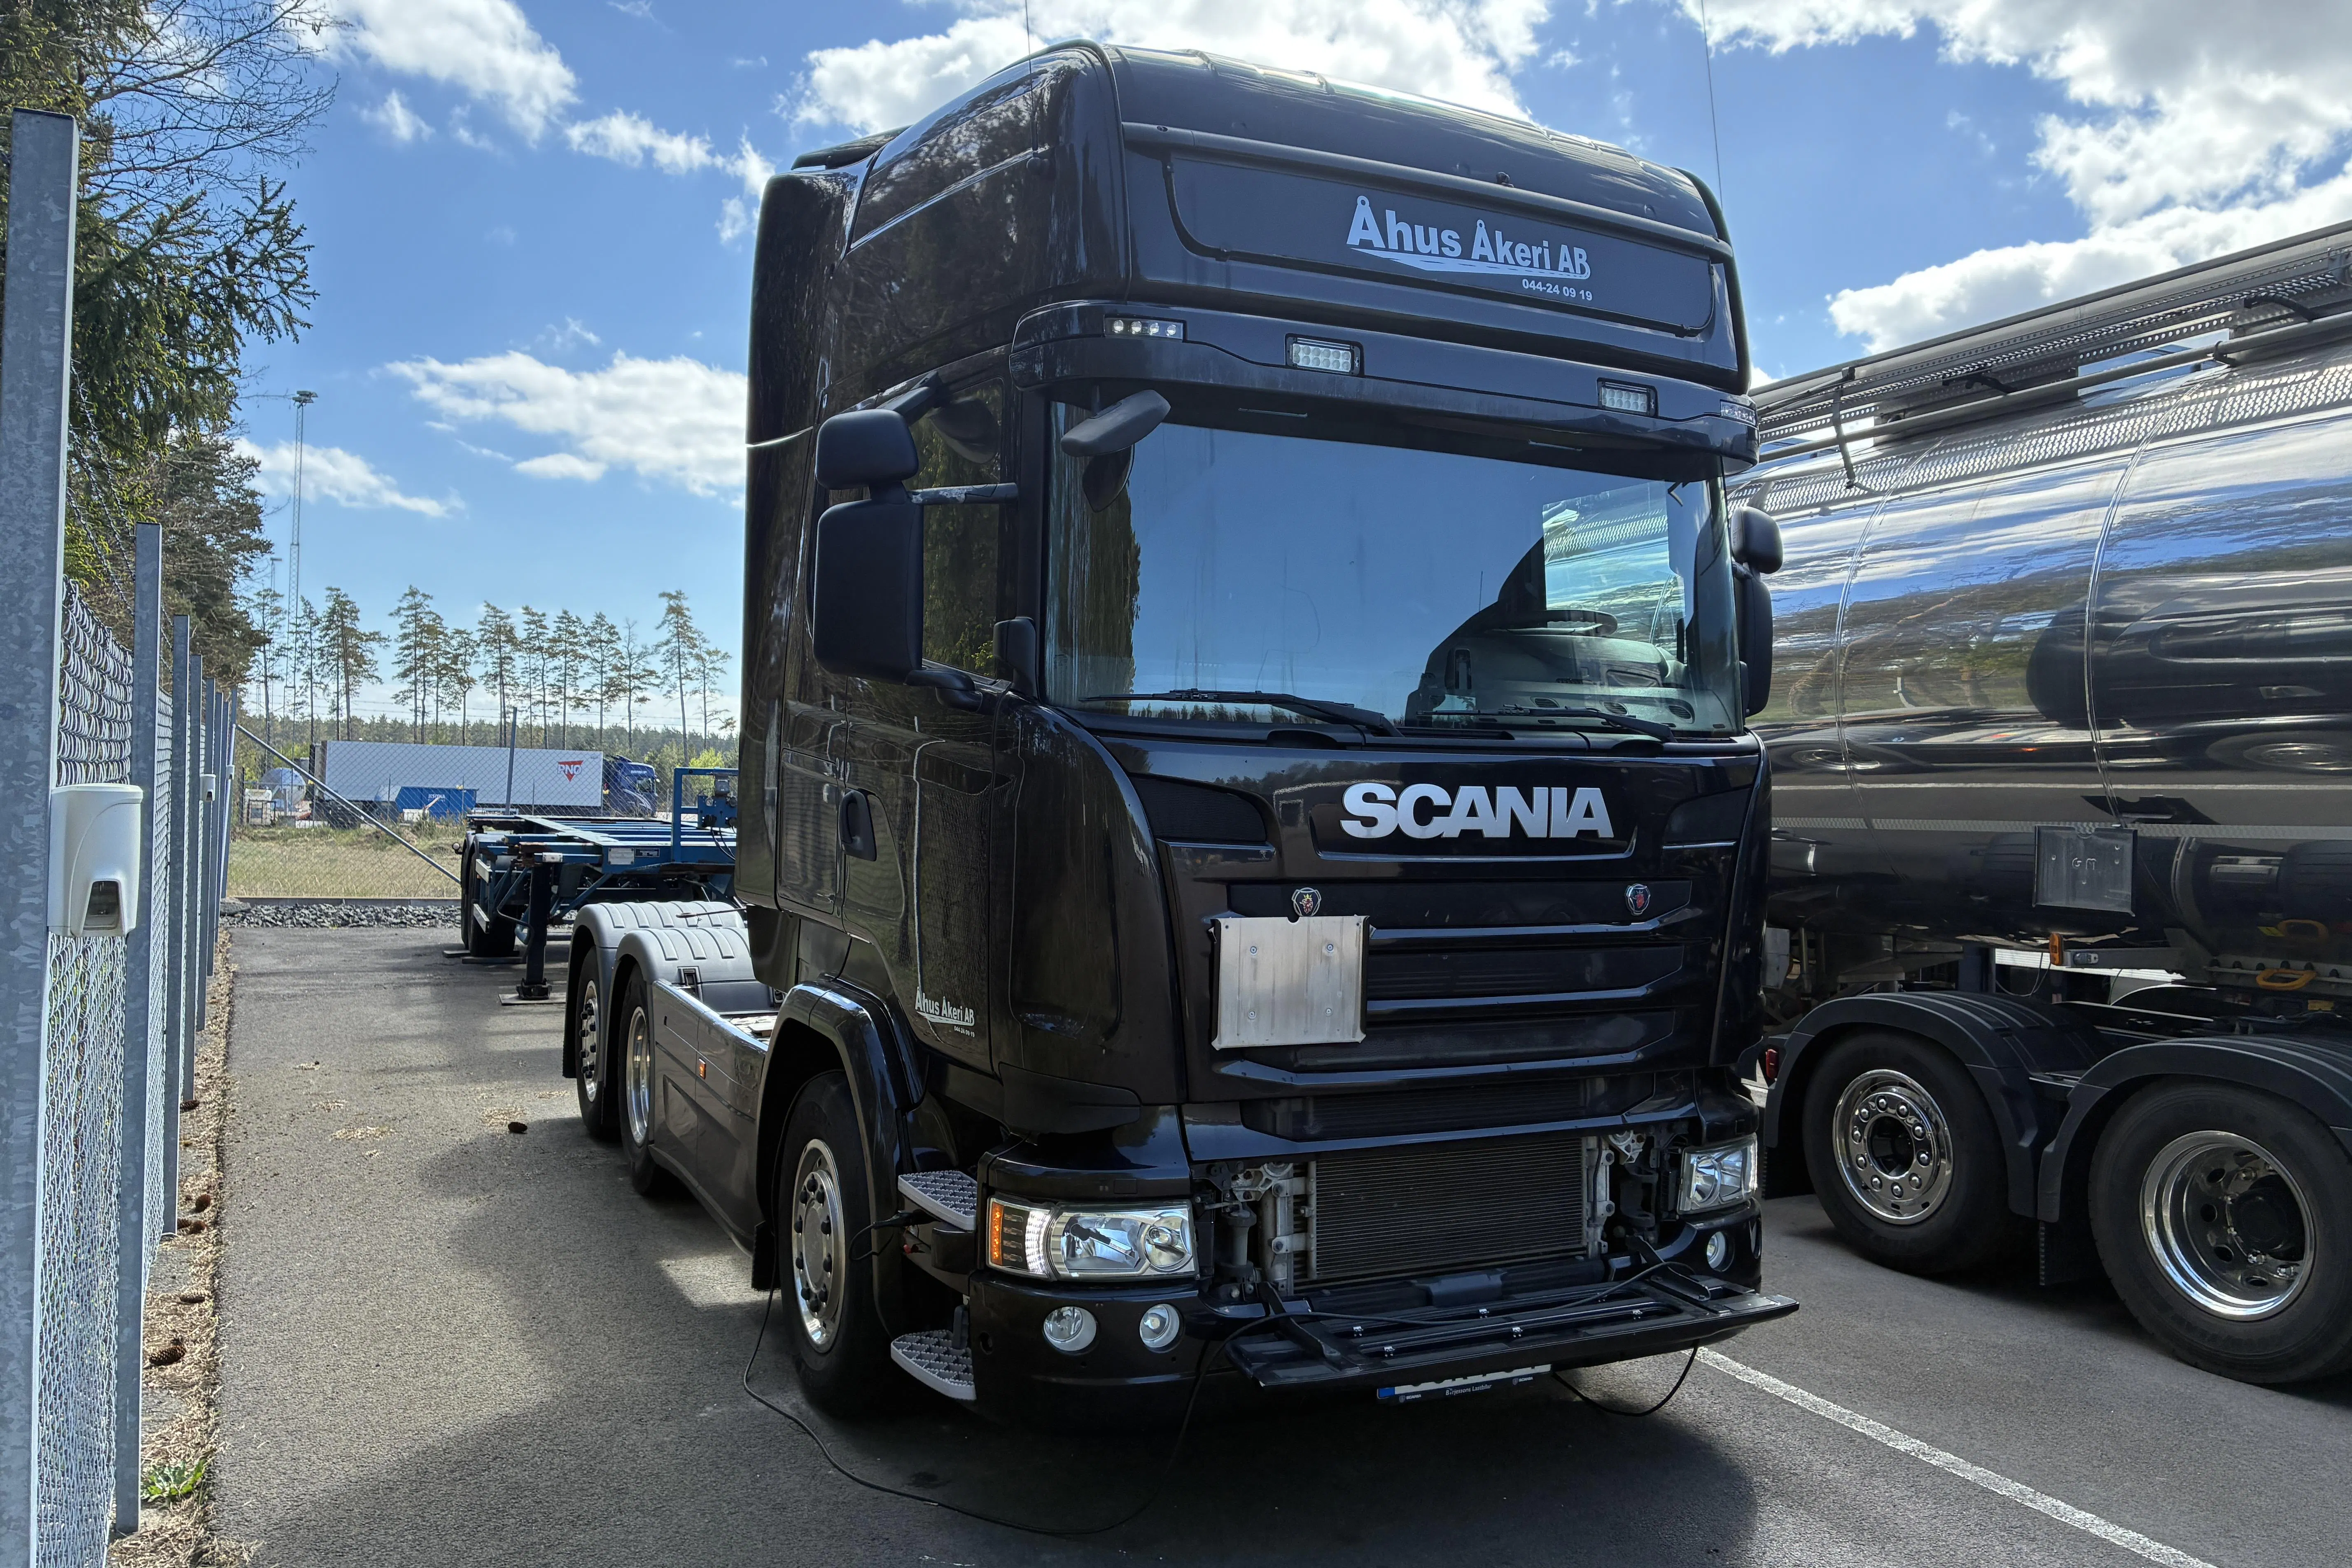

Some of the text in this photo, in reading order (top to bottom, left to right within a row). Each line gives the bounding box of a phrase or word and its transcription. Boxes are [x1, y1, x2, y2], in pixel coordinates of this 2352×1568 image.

[1346, 196, 1591, 278] Åhus Åkeri AB
[1522, 278, 1593, 301] 044-24 09 19
[558, 764, 582, 775] PNO
[1339, 782, 1614, 839] SCANIA
[964, 1008, 975, 1025] AB
